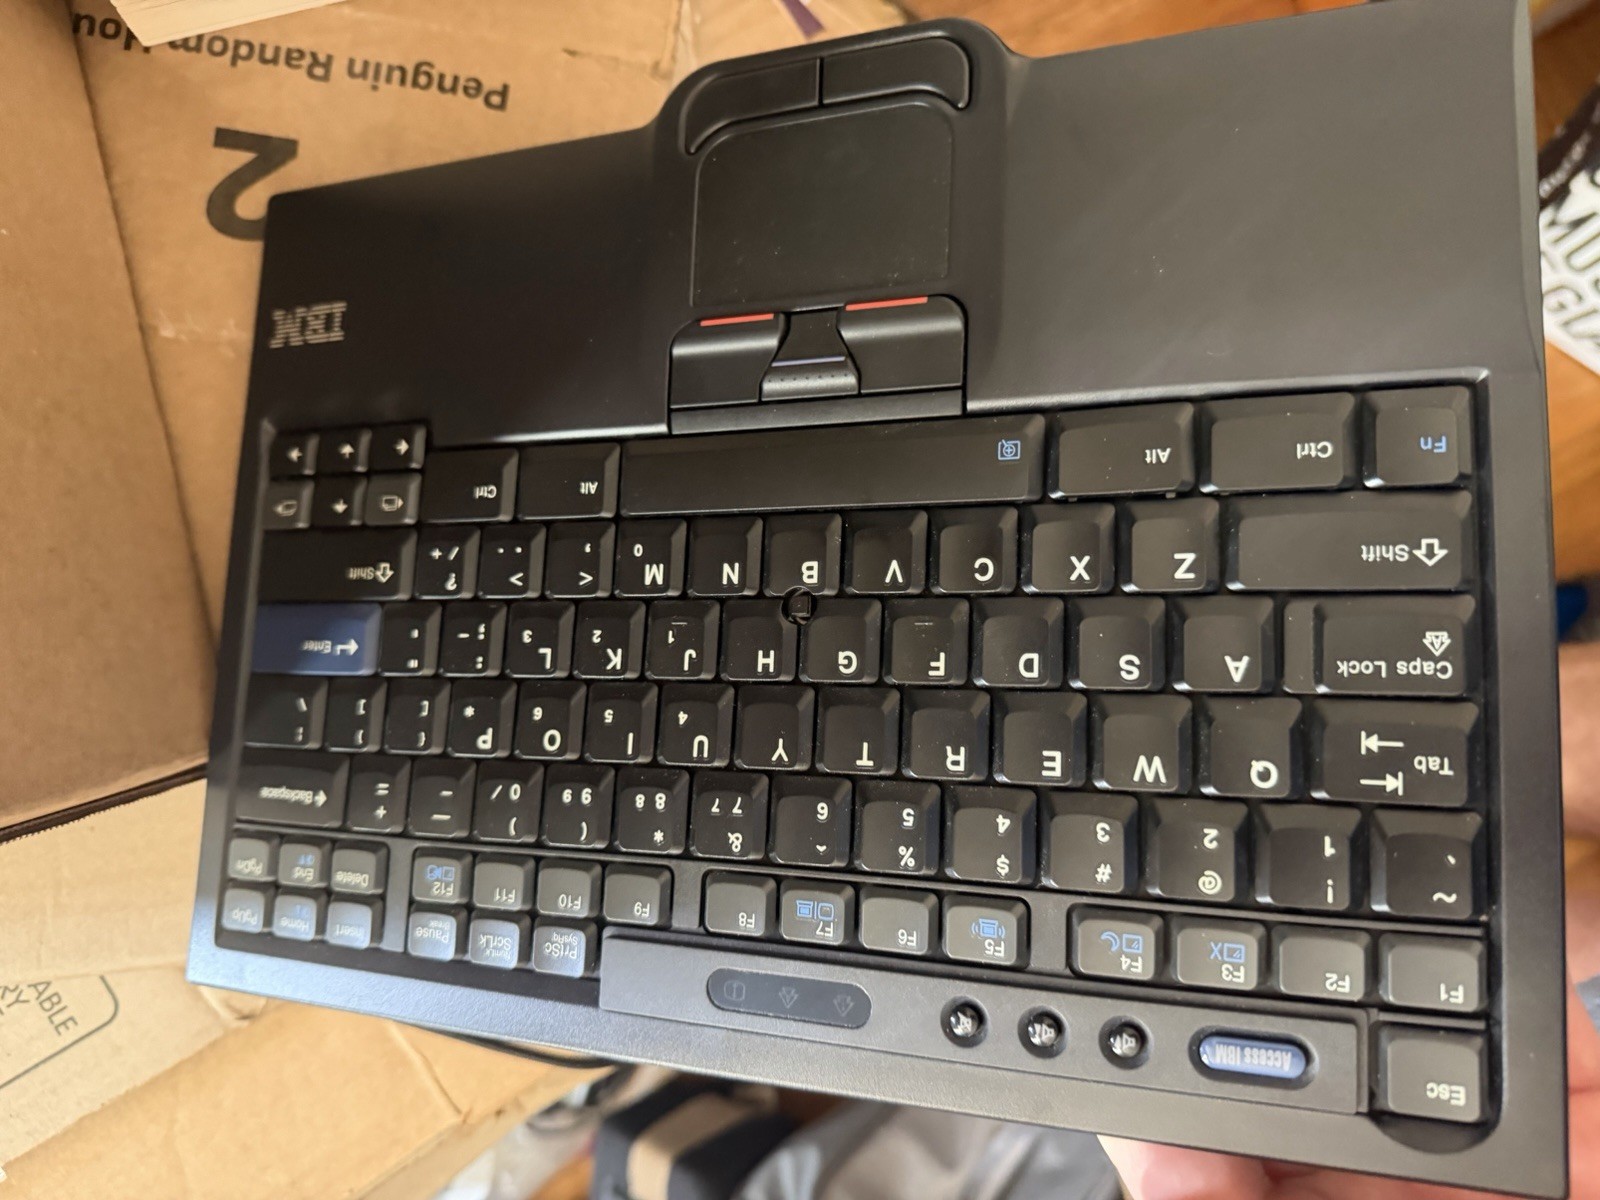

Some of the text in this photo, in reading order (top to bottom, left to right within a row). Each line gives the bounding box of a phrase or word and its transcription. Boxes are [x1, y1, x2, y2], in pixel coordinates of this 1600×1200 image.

[168, 34, 335, 84] Random
[346, 58, 511, 112] Penguin
[206, 127, 299, 242] 2
[269, 301, 348, 349] IBM
[1296, 441, 1333, 459] Ctrl
[1420, 436, 1447, 454] Fn
[1145, 448, 1171, 464] Alt
[474, 484, 497, 498] Ctrl
[580, 482, 598, 495] Alt
[1361, 544, 1409, 562] Shift
[348, 566, 375, 581] Shift
[644, 563, 664, 585] M
[722, 562, 739, 585] N
[801, 561, 819, 584] B
[885, 560, 903, 583] V
[974, 557, 994, 582] C
[1069, 555, 1091, 581] X
[1174, 553, 1196, 579] Z
[445, 572, 458, 590] ?
[509, 572, 524, 586] >
[579, 571, 593, 586] <
[302, 639, 332, 653] Enter
[522, 629, 533, 643] 3
[592, 629, 602, 644] 2
[667, 630, 675, 644] 1
[538, 647, 552, 670] L
[606, 648, 623, 670] K
[683, 649, 697, 671] J
[757, 650, 775, 673] H
[838, 651, 858, 674] G
[928, 652, 946, 676] F
[1019, 652, 1039, 678] D
[1119, 654, 1140, 680] S
[1337, 657, 1453, 679] Caps Lock
[1224, 655, 1250, 683] A
[532, 706, 543, 721] 6
[604, 709, 614, 723] 5
[678, 711, 688, 725] 4
[476, 727, 493, 749] P
[543, 729, 561, 752] O
[627, 732, 634, 756] I
[693, 735, 709, 758] U
[771, 738, 789, 762] Y
[856, 742, 874, 766] T
[945, 745, 966, 771] R
[1041, 750, 1062, 777] E
[1133, 755, 1166, 783] W
[1413, 755, 1454, 776] Tab
[1250, 760, 1279, 789] Q
[260, 785, 313, 804] Backspace
[562, 788, 592, 804] 9 9
[635, 793, 666, 811] 8 8
[711, 797, 742, 814] 7 7
[817, 802, 829, 820] 6
[509, 817, 518, 836] )
[902, 808, 915, 828] 5
[996, 814, 1011, 834] 4
[580, 821, 587, 841] (
[1096, 822, 1111, 842] 3
[1203, 828, 1218, 849] 2
[727, 832, 742, 853] &
[1324, 836, 1336, 857] 1
[898, 846, 915, 868] %
[996, 854, 1010, 877] $
[291, 867, 314, 880] End
[336, 871, 369, 886] Delete
[1095, 863, 1112, 883] #
[1198, 871, 1222, 895] @
[432, 881, 454, 896] F12
[496, 887, 516, 902] F11
[1327, 879, 1334, 904] !
[559, 893, 581, 909] F10
[634, 902, 650, 917] F9
[231, 908, 258, 924] PgUp
[280, 917, 308, 932] Home
[739, 912, 756, 929] F8
[416, 927, 450, 943] Pause
[816, 921, 834, 937] F7
[898, 929, 917, 947] F6
[480, 934, 512, 950] ScrLk
[545, 942, 578, 959] PrtSc
[985, 939, 1005, 957] F5
[1120, 954, 1143, 973] F4
[1222, 964, 1245, 983] F3
[1325, 973, 1350, 993] F2
[1440, 983, 1464, 1004] F1
[27, 981, 78, 1036] ABLE
[1244, 1047, 1292, 1071] Access
[1426, 1082, 1466, 1106] Esc
